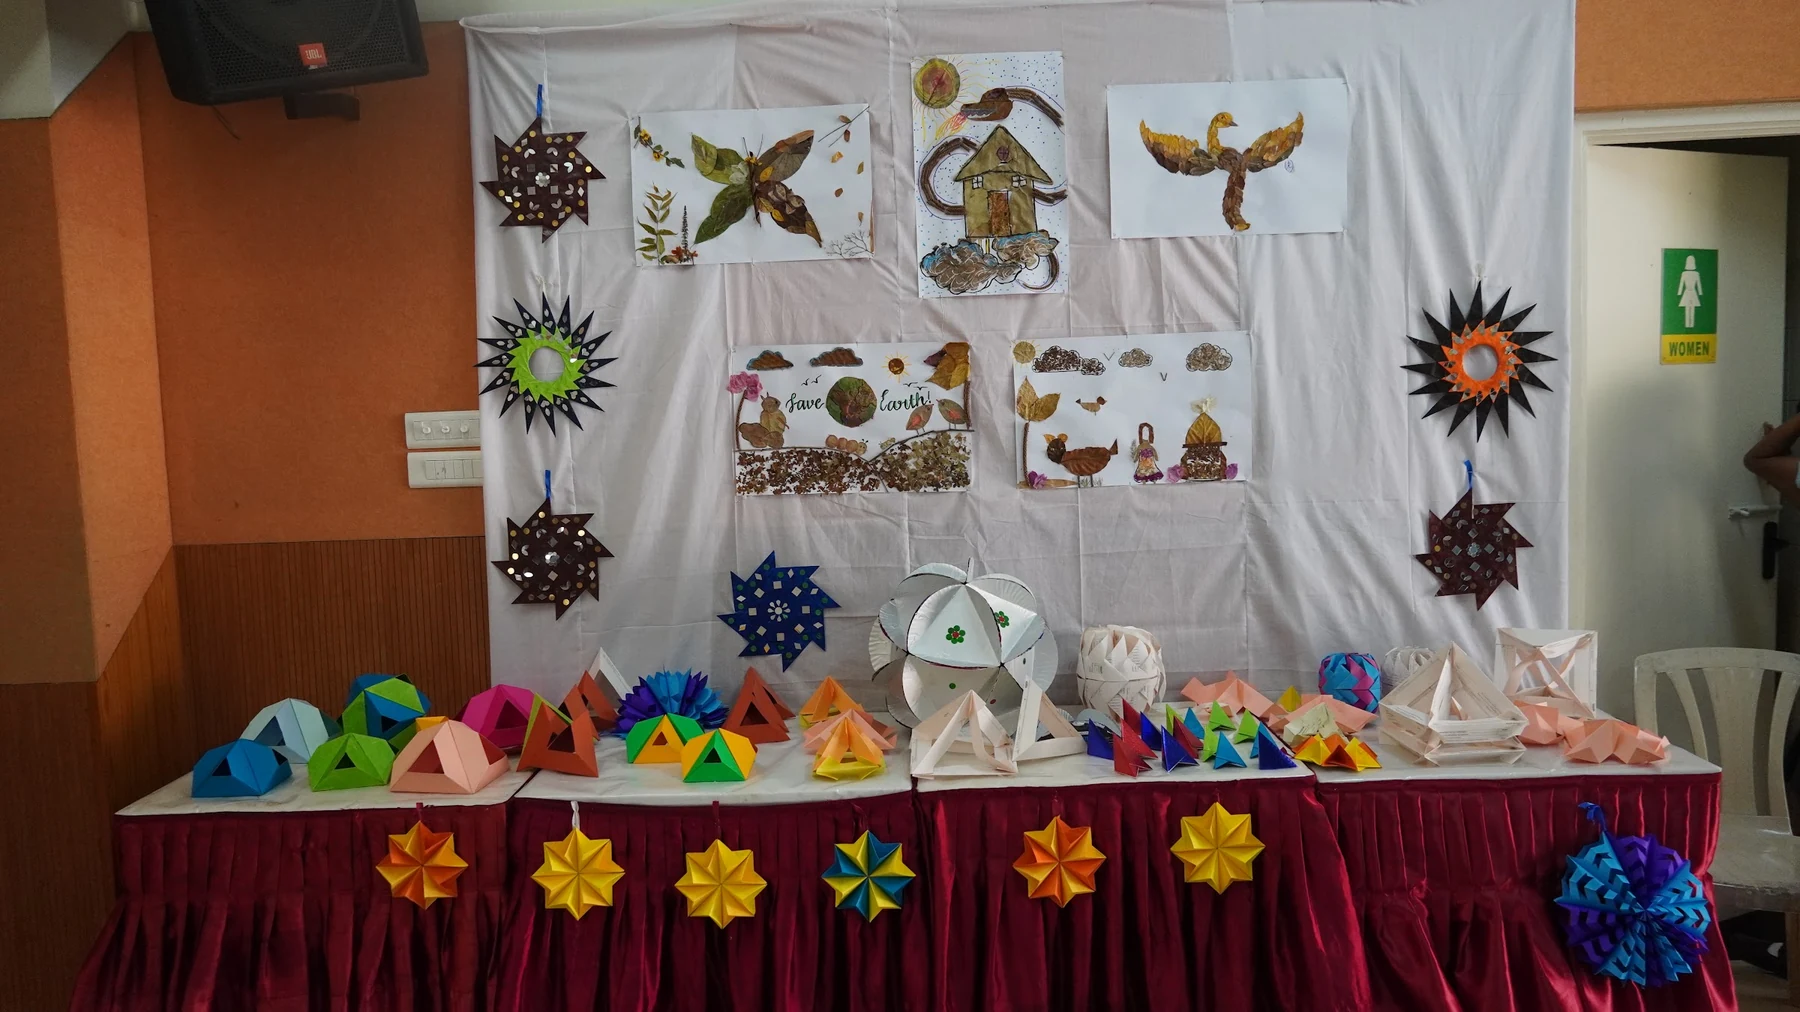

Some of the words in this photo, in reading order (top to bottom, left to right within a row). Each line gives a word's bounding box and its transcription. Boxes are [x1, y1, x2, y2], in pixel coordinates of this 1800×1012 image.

[305, 49, 322, 60] JBL
[1668, 341, 1710, 357] WOMEN
[785, 392, 825, 413] Save
[879, 389, 932, 412] Earth!
